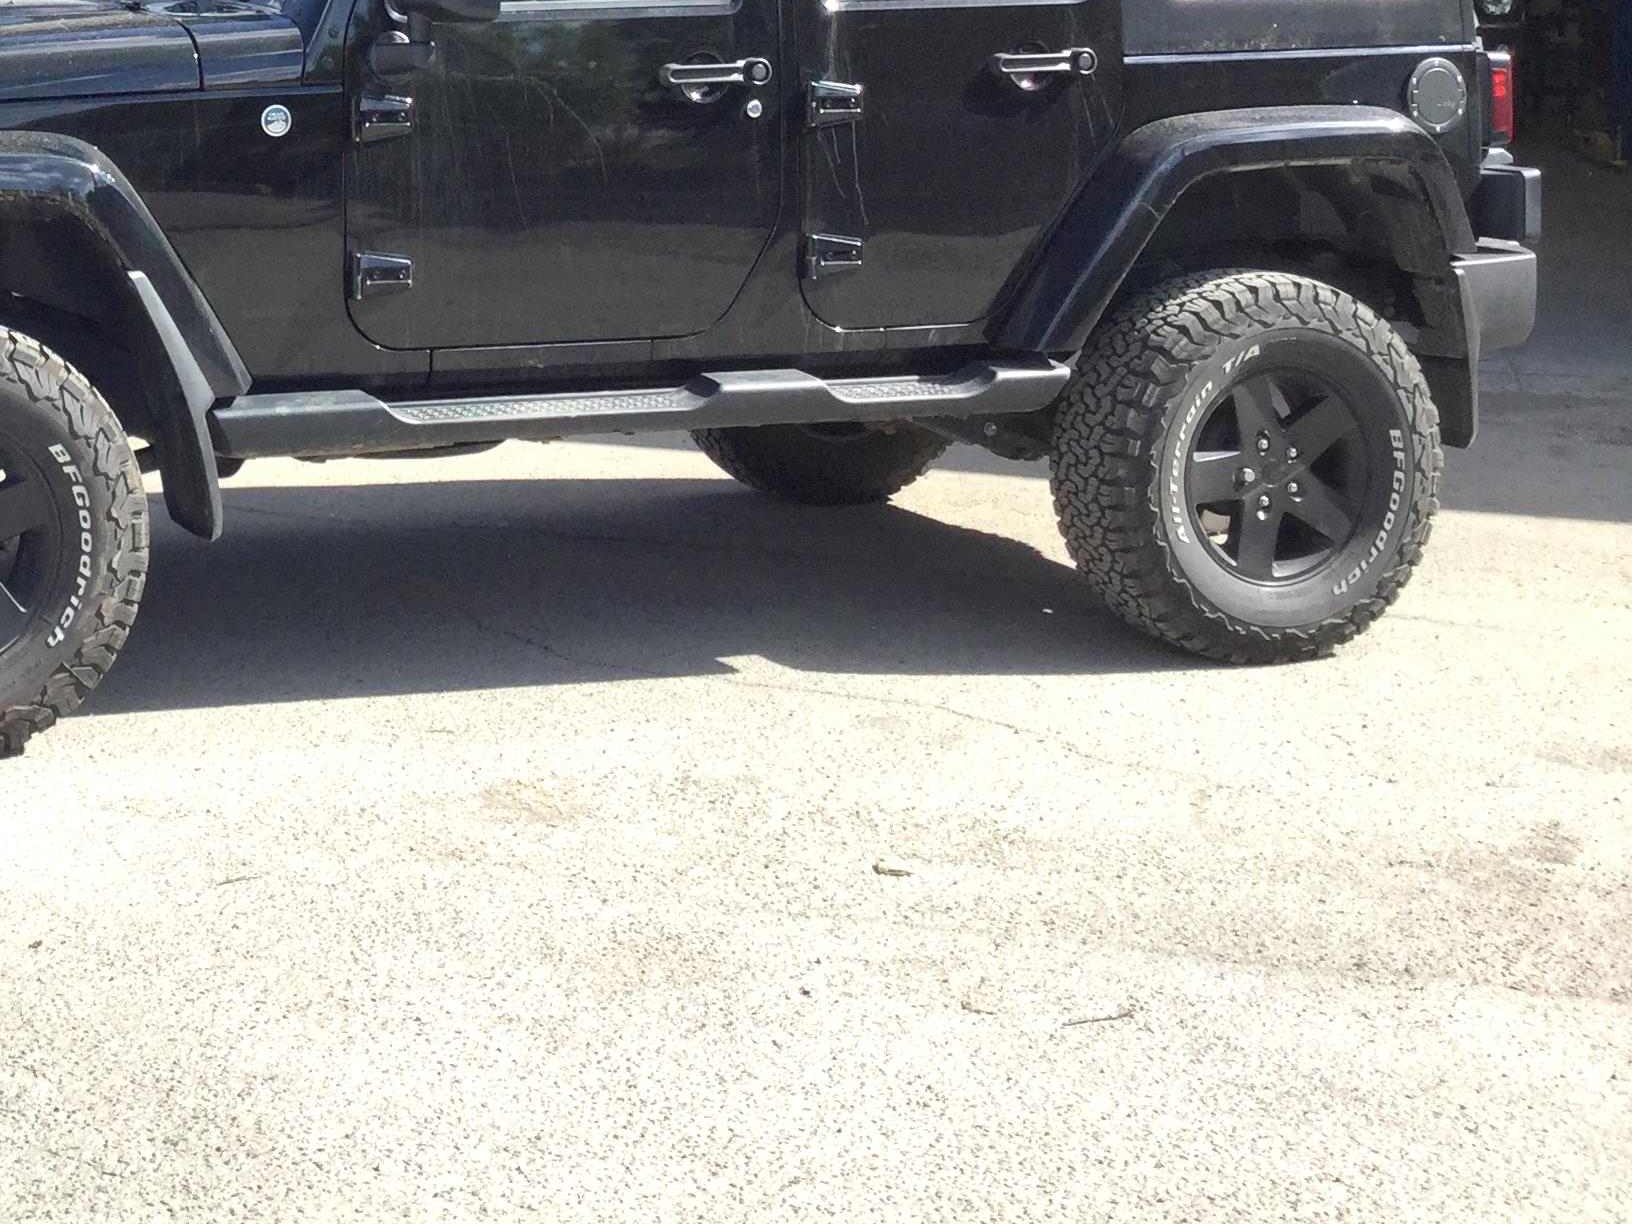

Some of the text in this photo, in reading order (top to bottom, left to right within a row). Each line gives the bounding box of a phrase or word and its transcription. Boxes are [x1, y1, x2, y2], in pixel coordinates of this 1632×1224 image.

[1222, 344, 1261, 375] T/A
[1169, 380, 1213, 544] All-Terrain
[1332, 428, 1406, 596] BFGoodrich
[46, 443, 93, 648] BFGoodrich
